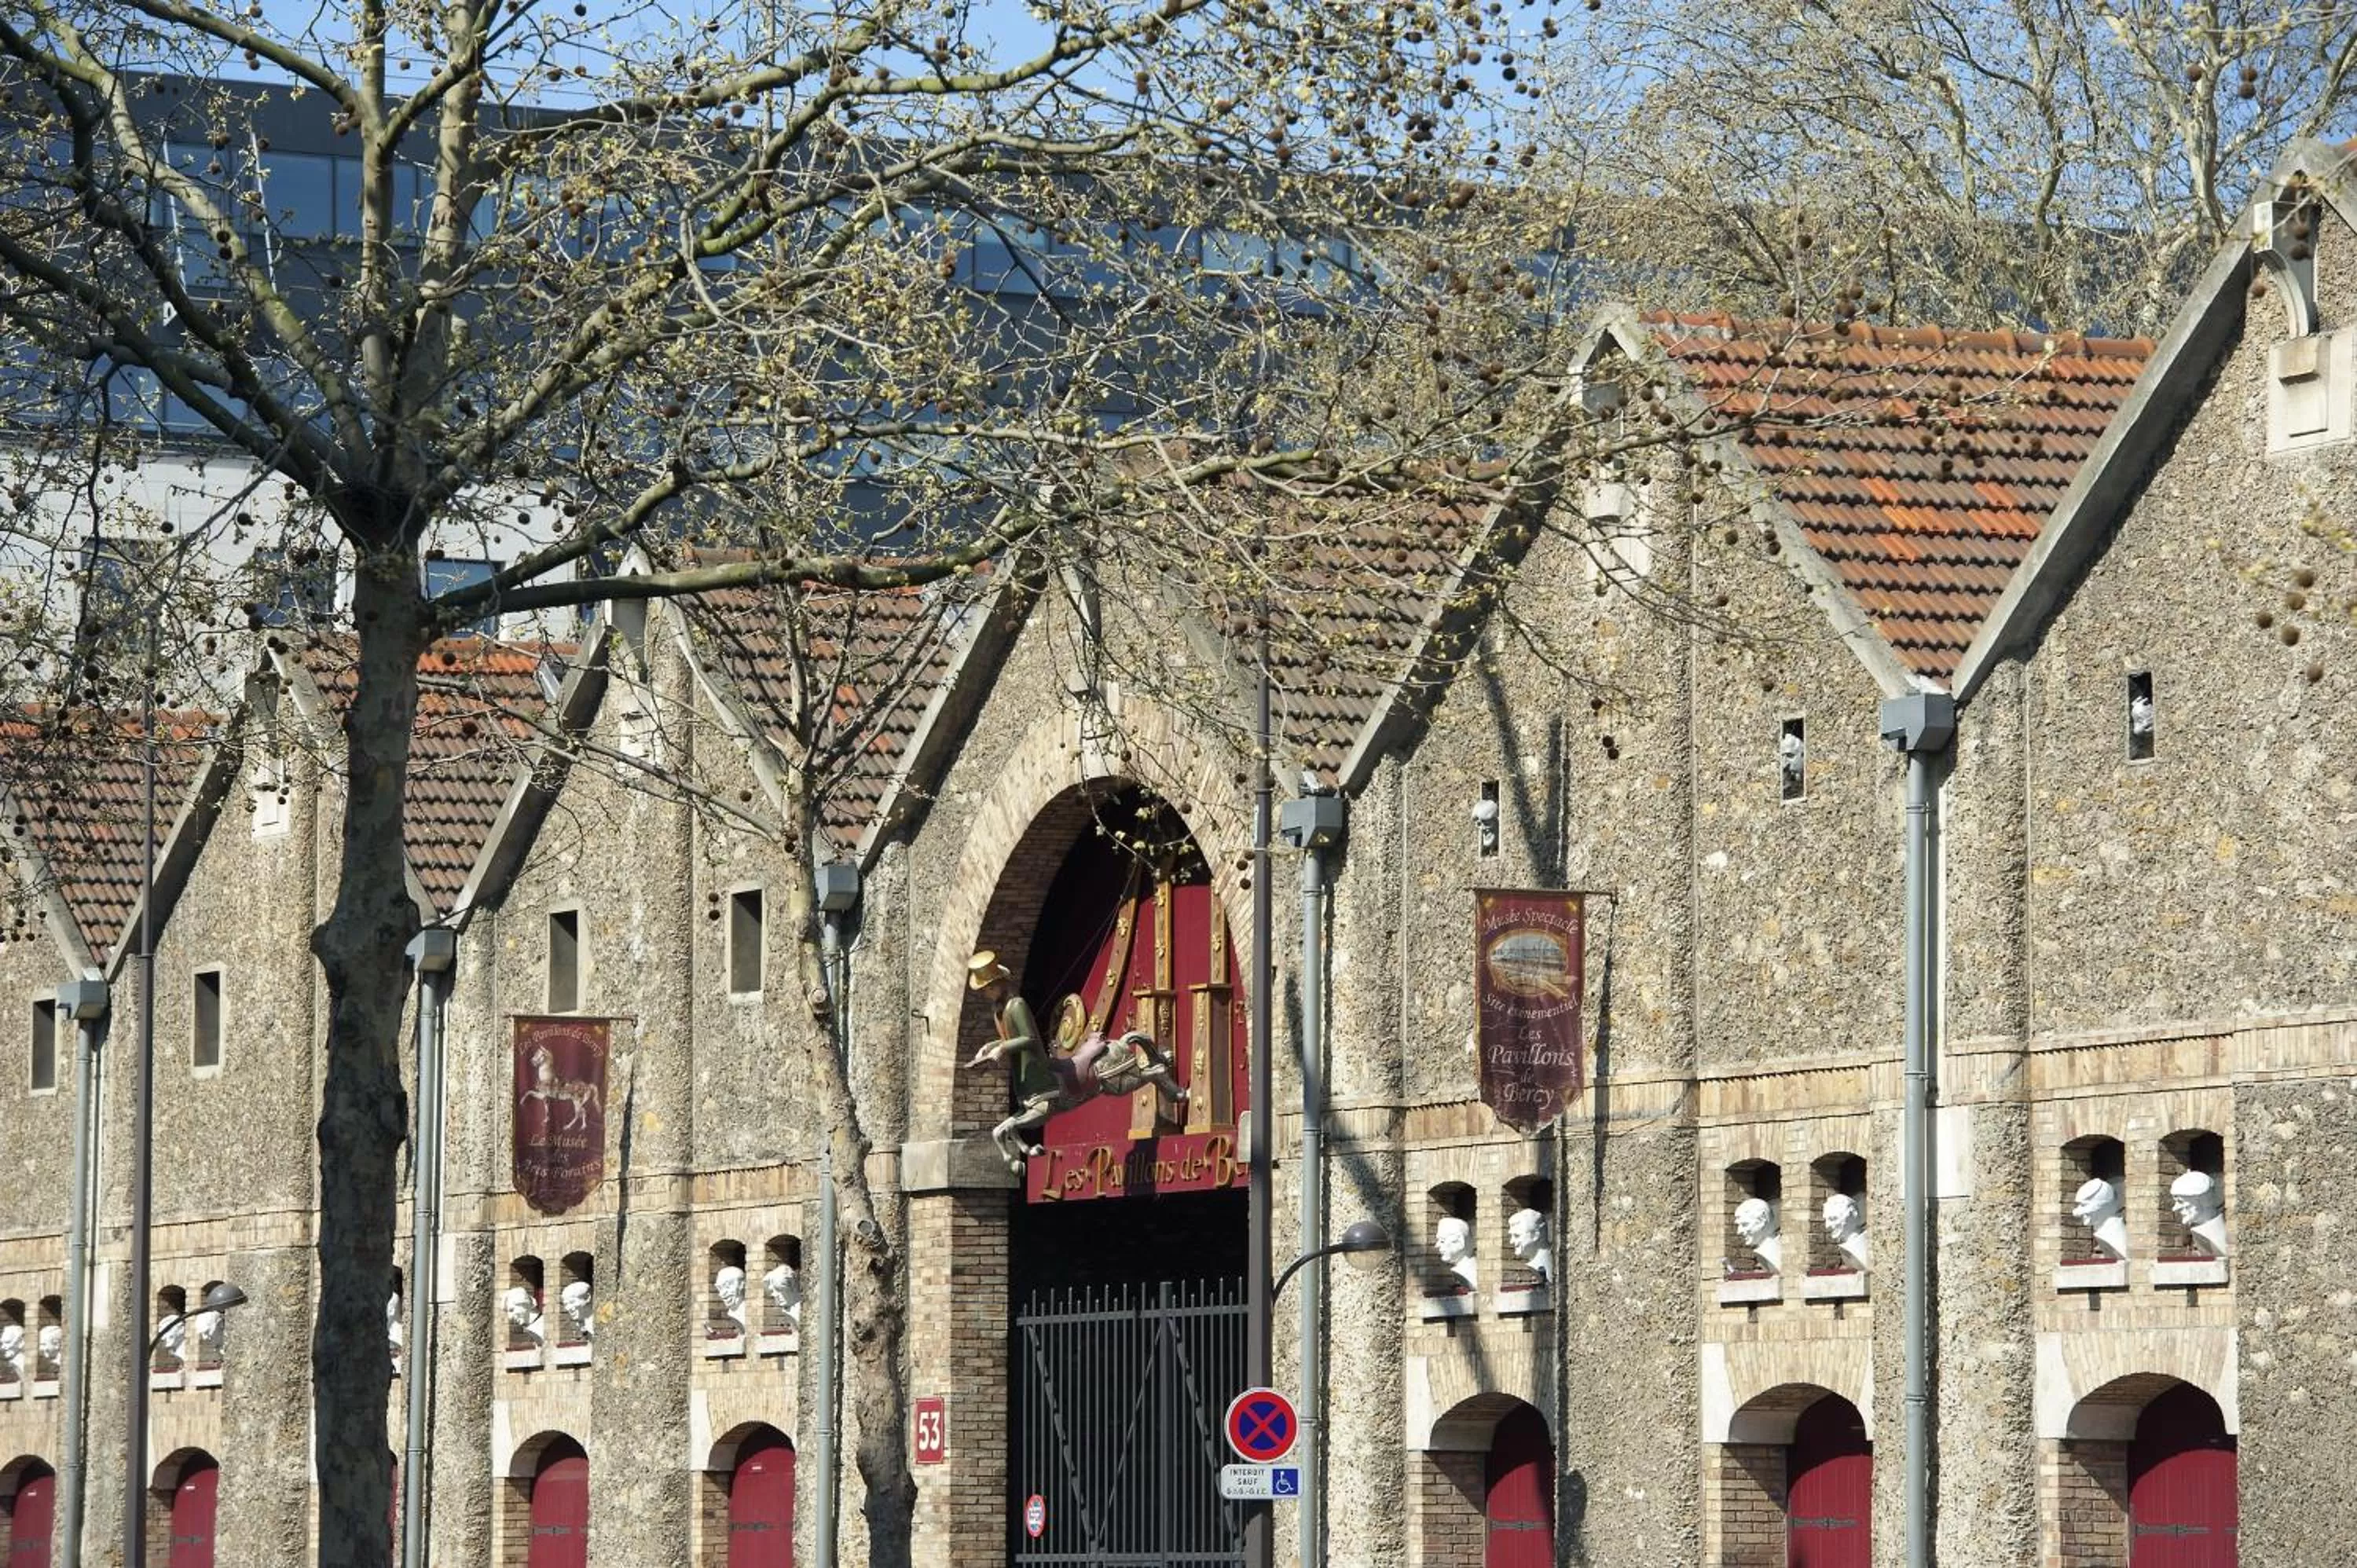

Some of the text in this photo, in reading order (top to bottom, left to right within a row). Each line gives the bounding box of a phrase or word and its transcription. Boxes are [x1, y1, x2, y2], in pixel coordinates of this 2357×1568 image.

[1522, 908, 1578, 934] Spectacle
[1519, 1026, 1541, 1041] Les
[1487, 1042, 1574, 1066] Pavillons
[1504, 1083, 1554, 1110] Bercy
[1042, 1149, 1086, 1202] Les
[1180, 1147, 1202, 1182] de
[918, 1412, 940, 1452] 53
